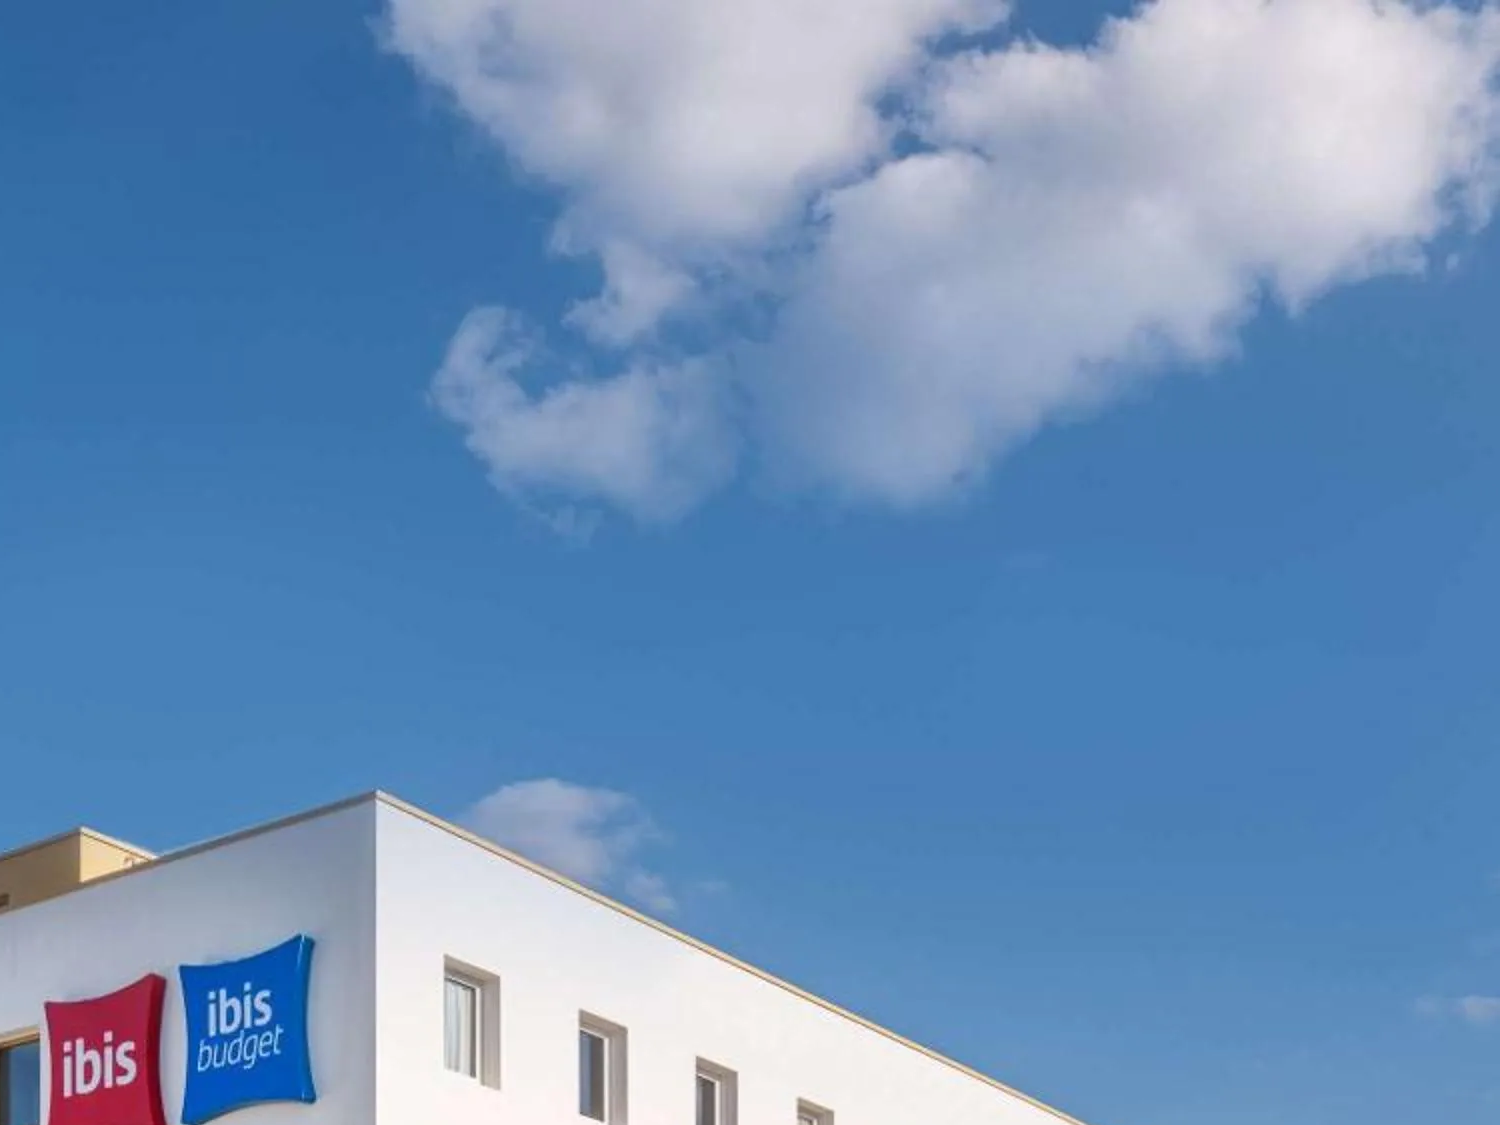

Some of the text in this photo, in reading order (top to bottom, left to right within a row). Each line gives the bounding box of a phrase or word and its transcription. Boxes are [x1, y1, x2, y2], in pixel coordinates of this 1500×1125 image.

[208, 982, 273, 1038] ibis
[62, 1031, 137, 1098] ibis
[197, 1023, 284, 1073] budget
